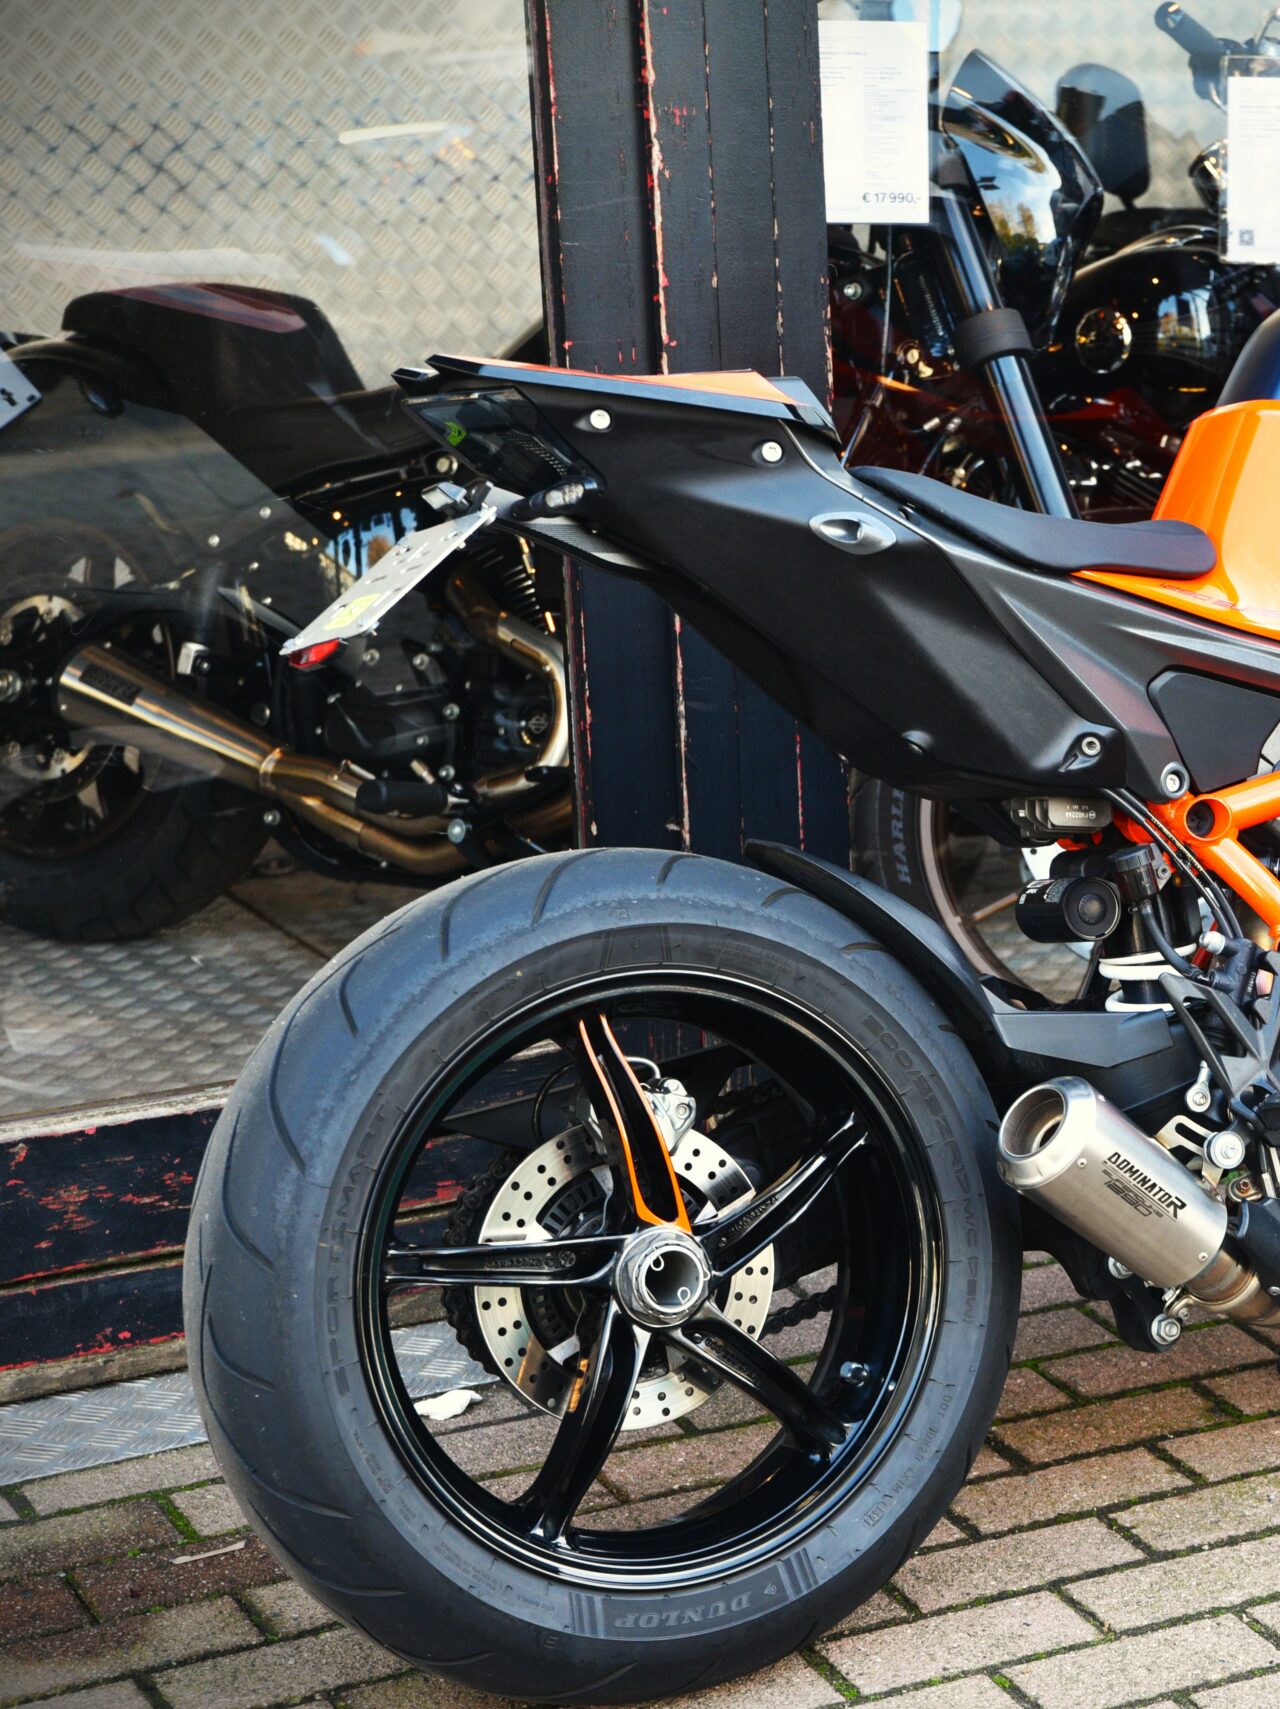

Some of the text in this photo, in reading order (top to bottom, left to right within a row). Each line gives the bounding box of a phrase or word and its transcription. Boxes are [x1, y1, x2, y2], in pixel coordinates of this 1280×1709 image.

[1104, 1180, 1152, 1217] 1290
[1107, 1151, 1187, 1219] DOMINATOR
[614, 1590, 752, 1629] DUNLOP
